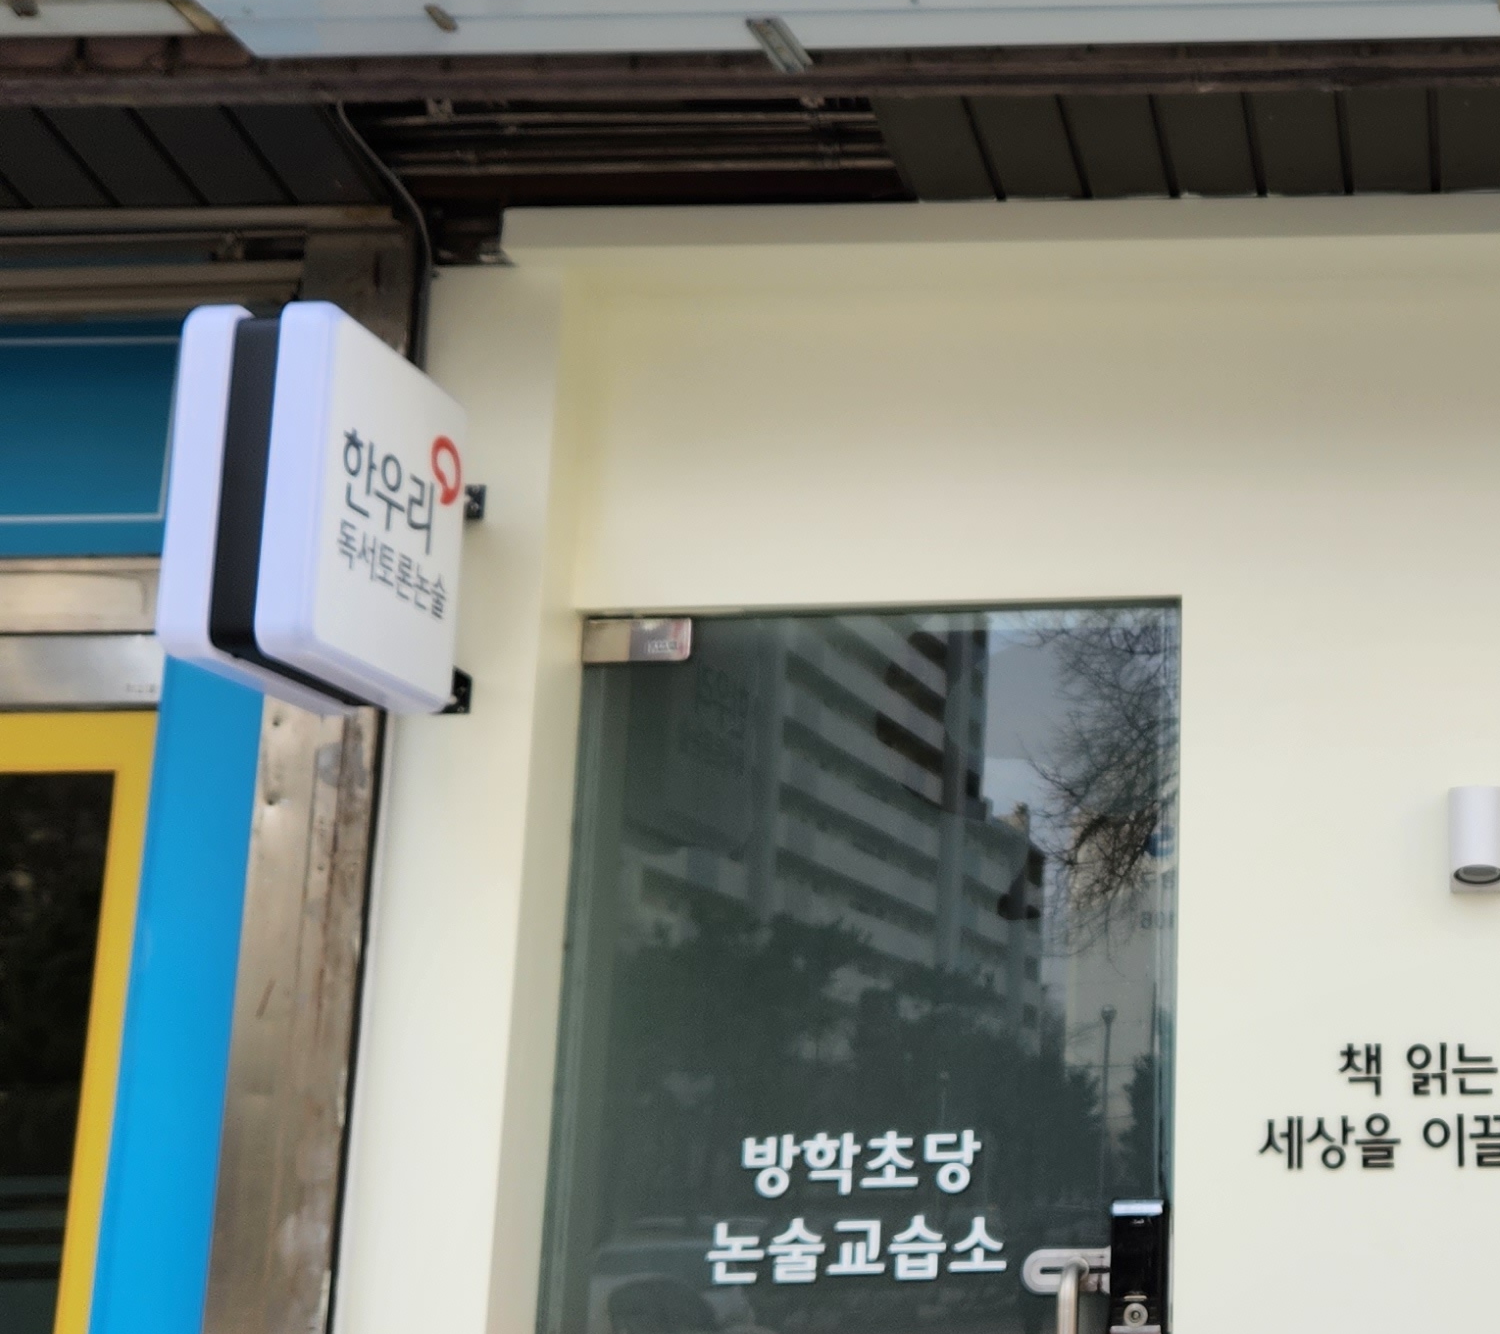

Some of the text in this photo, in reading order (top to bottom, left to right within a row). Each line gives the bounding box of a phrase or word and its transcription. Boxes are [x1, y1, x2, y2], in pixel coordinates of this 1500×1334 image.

[343, 427, 435, 555] 한우리
[337, 517, 446, 620] 독서토론논술
[1338, 1042, 1382, 1097] 책
[1406, 1041, 1499, 1097] 읽는
[742, 1128, 982, 1198] 방학초당
[1258, 1112, 1402, 1170] 세상을
[706, 1213, 1008, 1285] 논술교습소
